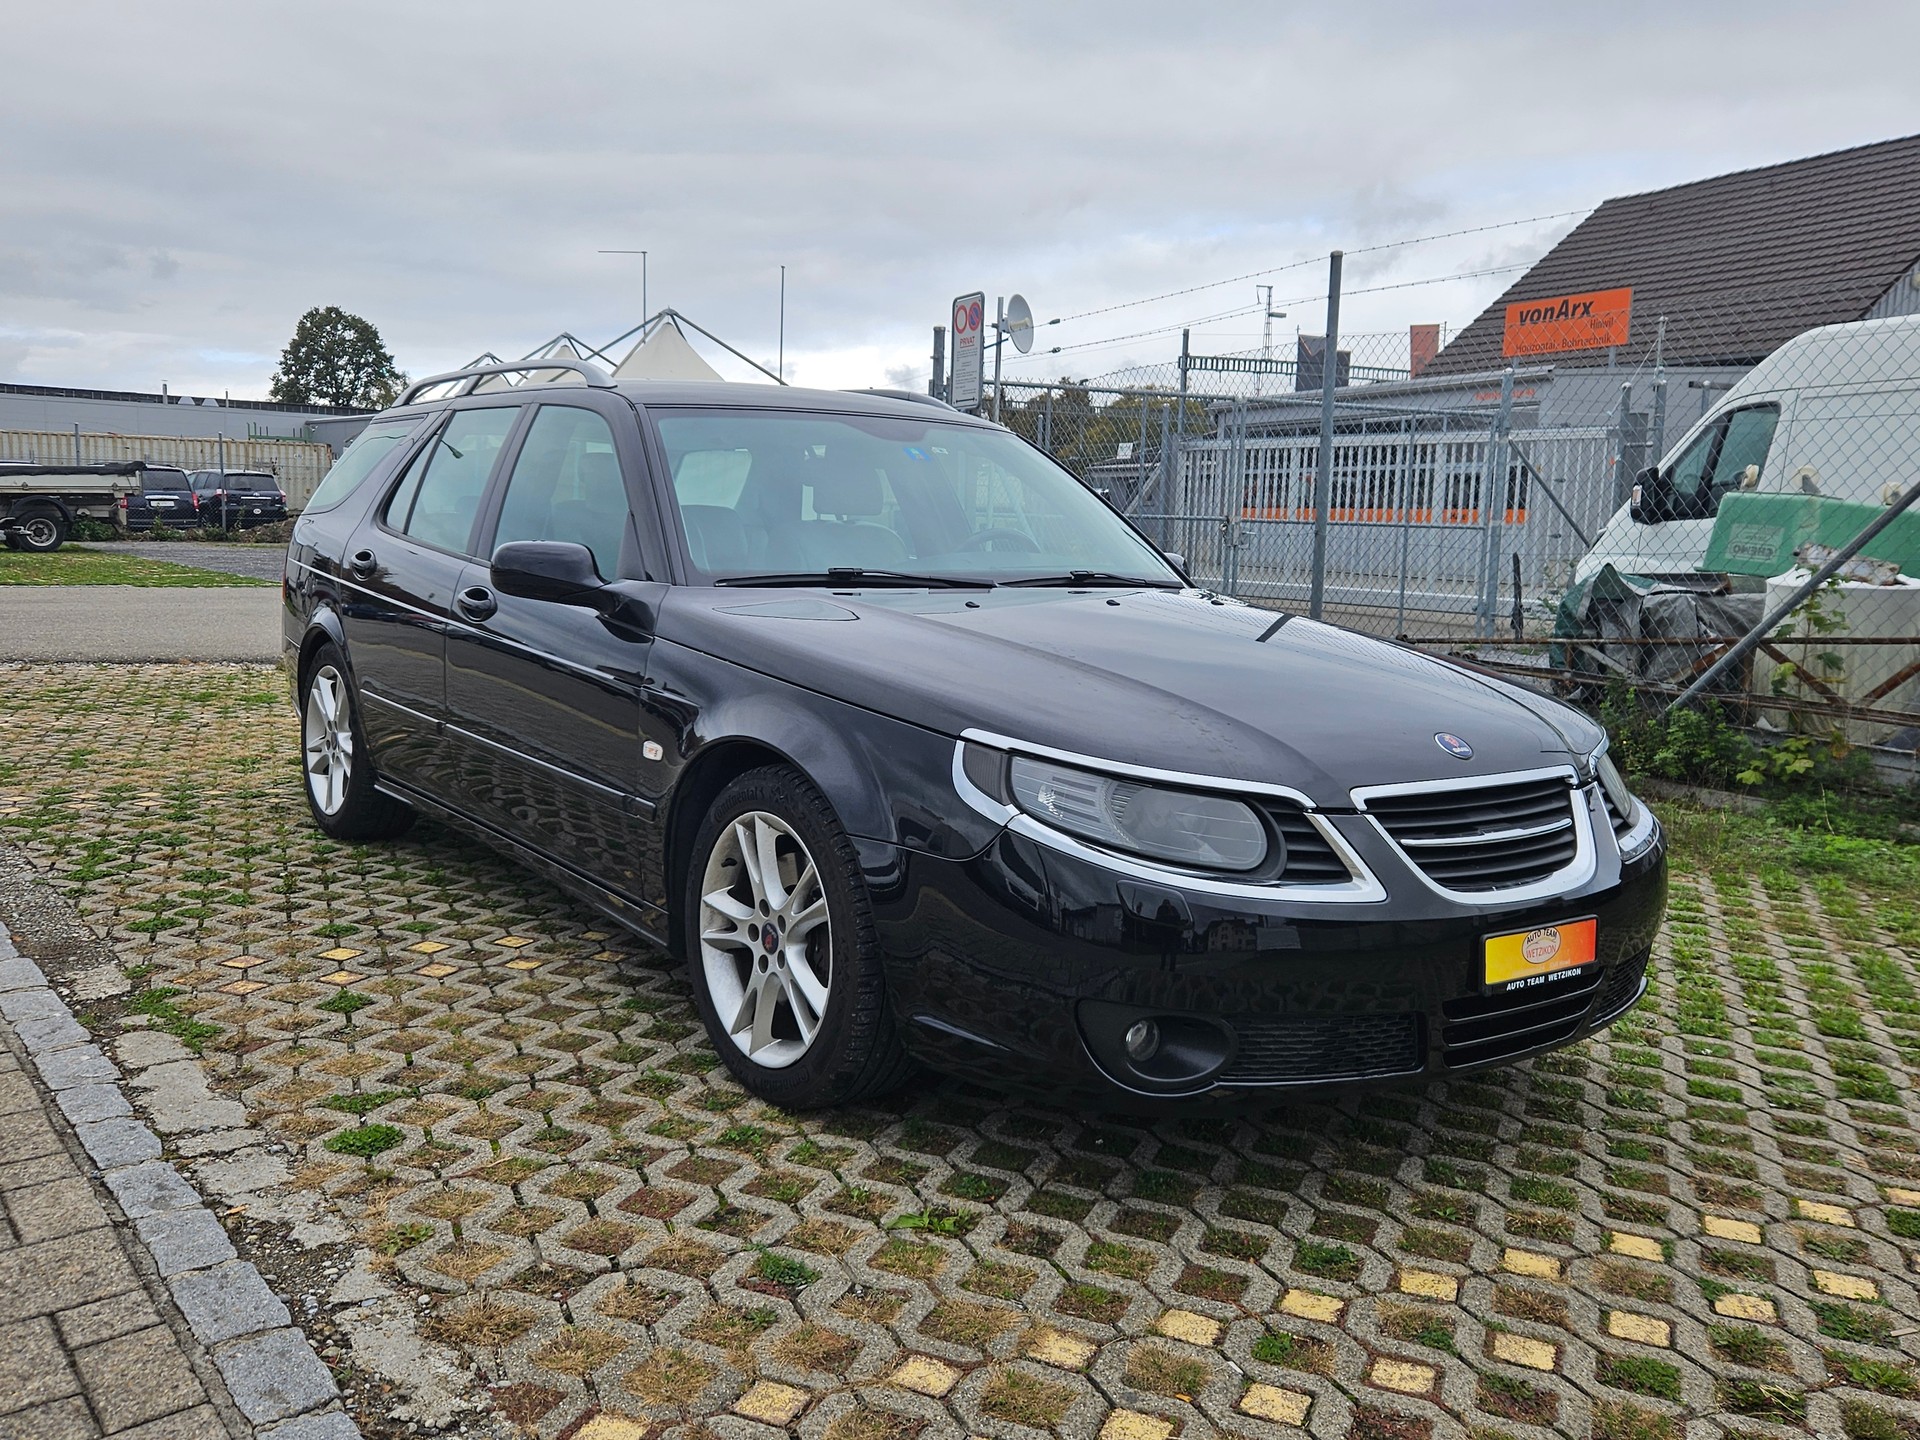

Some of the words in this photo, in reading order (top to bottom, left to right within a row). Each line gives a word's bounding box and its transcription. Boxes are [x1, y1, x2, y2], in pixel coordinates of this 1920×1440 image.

[1519, 299, 1594, 326] vonArx
[960, 337, 975, 346] PRIVAT
[1526, 929, 1541, 944] AUTO
[1543, 928, 1557, 939] TEAM
[1526, 945, 1557, 958] WETZIKON
[1507, 981, 1525, 991] AUTO
[1527, 976, 1545, 986] TEAM
[1548, 968, 1581, 982] WETZIKON
